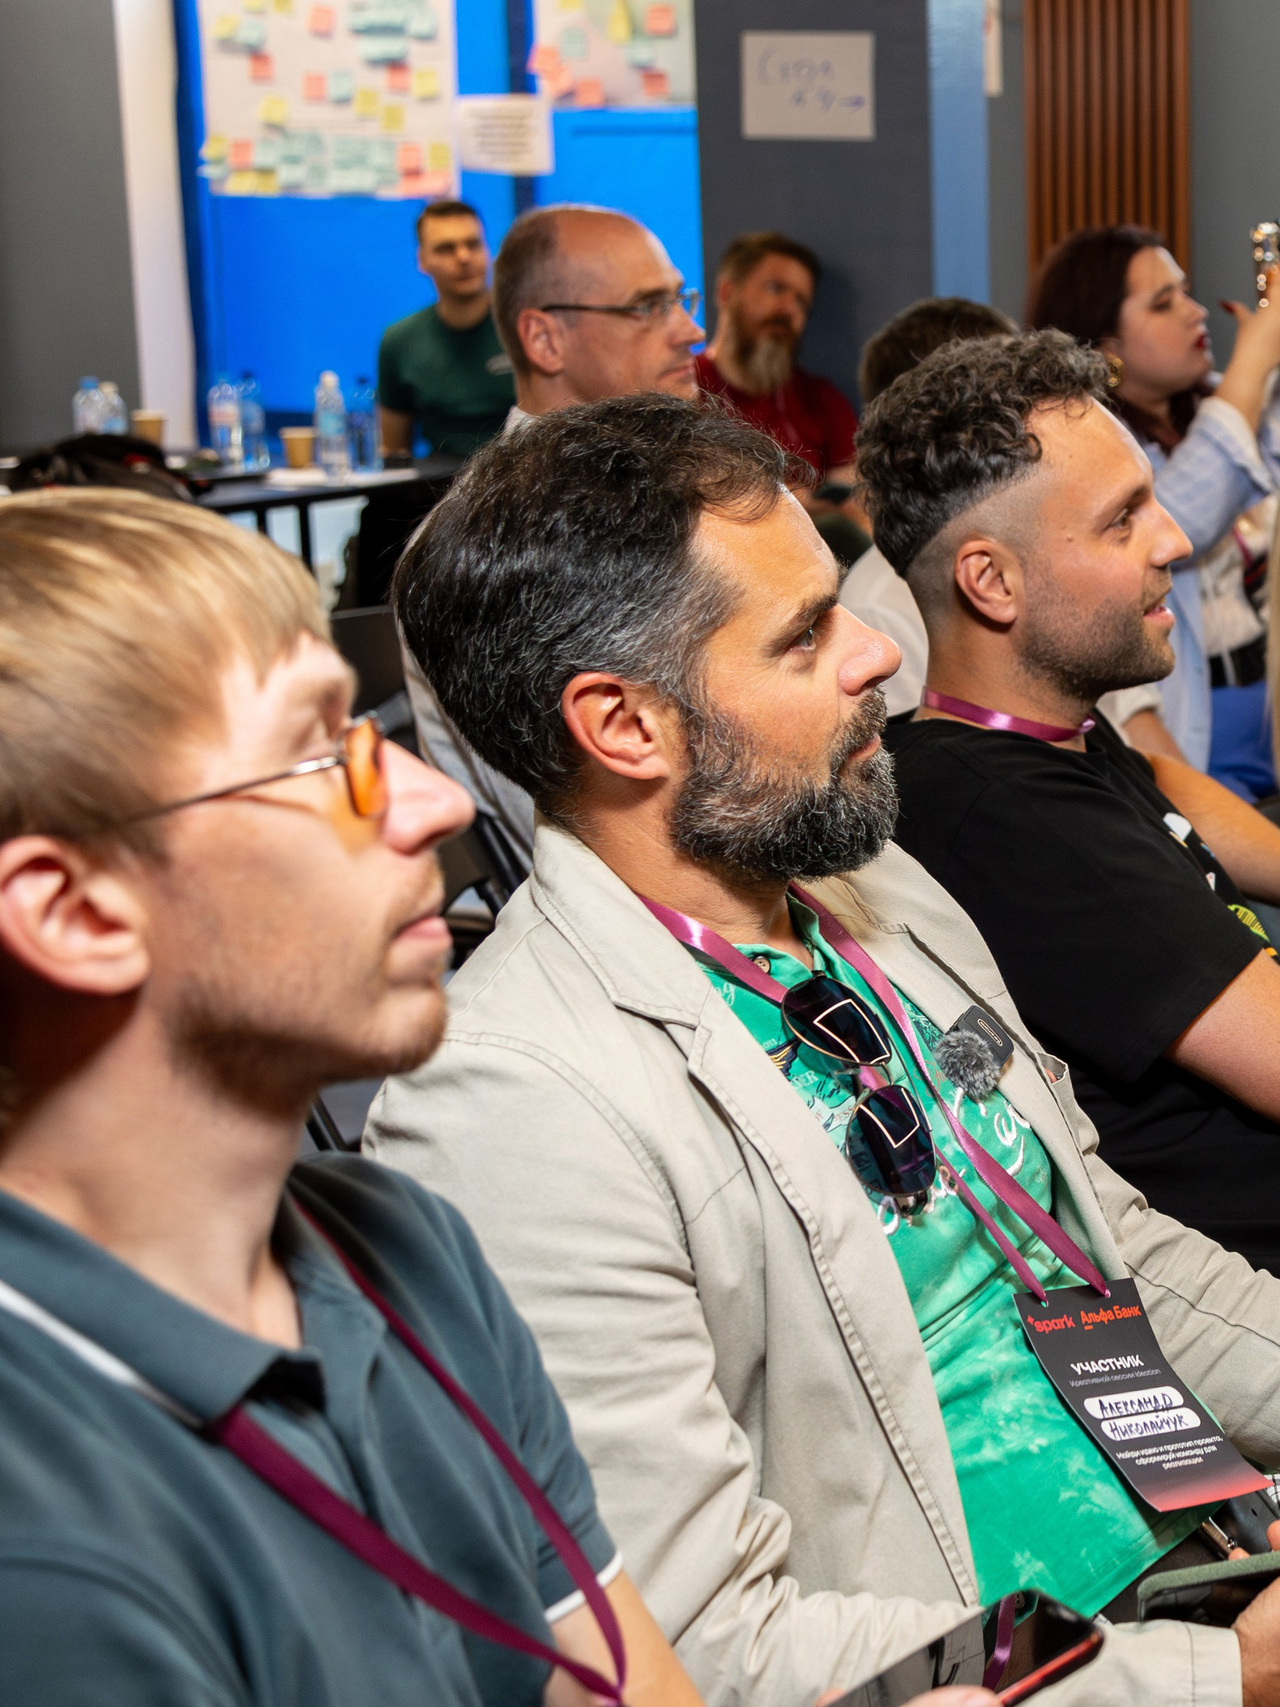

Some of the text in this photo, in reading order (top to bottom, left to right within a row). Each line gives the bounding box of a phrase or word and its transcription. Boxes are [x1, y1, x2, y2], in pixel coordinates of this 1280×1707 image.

[1034, 1314, 1075, 1334] spark
[1080, 1305, 1142, 1326] Альфа Банк
[1070, 1354, 1144, 1376] УЧАСТНИК
